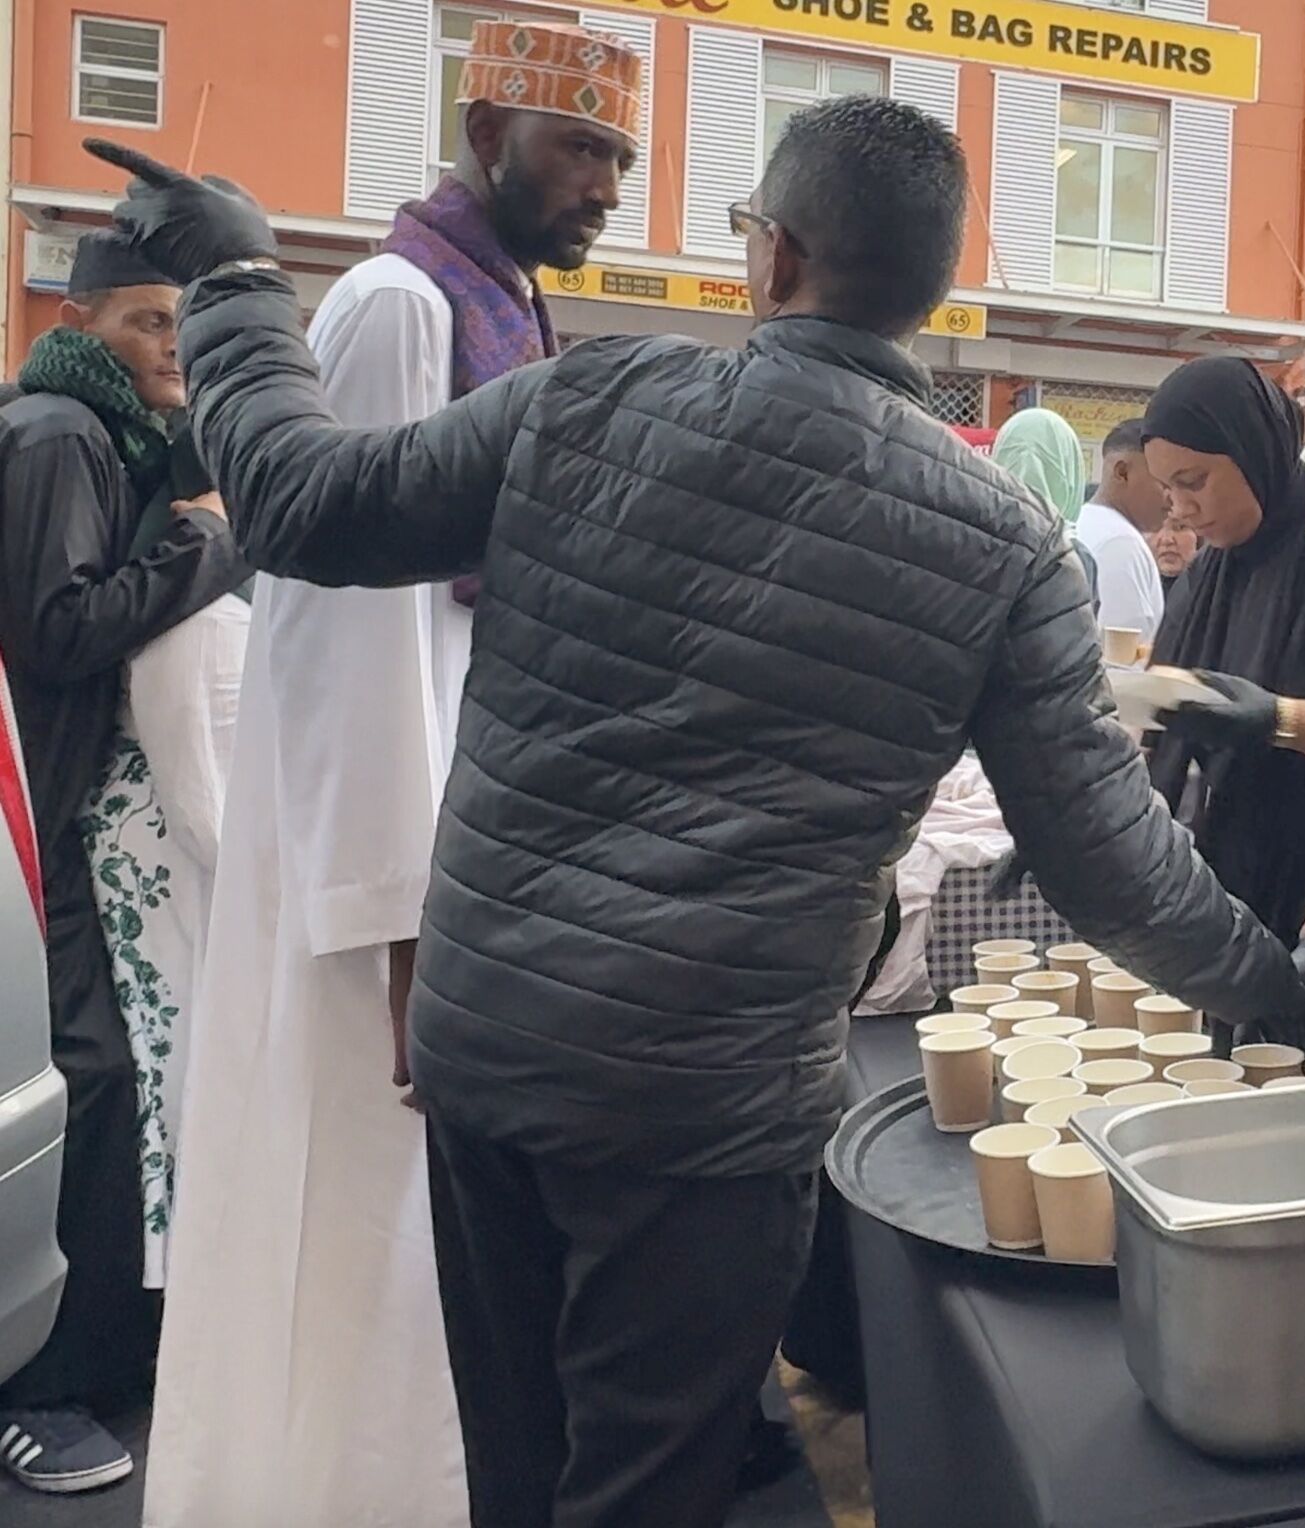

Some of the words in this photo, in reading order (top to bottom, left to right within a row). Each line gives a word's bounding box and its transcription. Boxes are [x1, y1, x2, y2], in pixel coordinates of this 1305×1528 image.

[906, 3, 933, 32] &
[951, 9, 1033, 47] BAG
[1048, 24, 1211, 75] REPAIRS
[562, 271, 580, 286] 65
[699, 296, 737, 310] SHOE
[950, 314, 966, 327] 65
